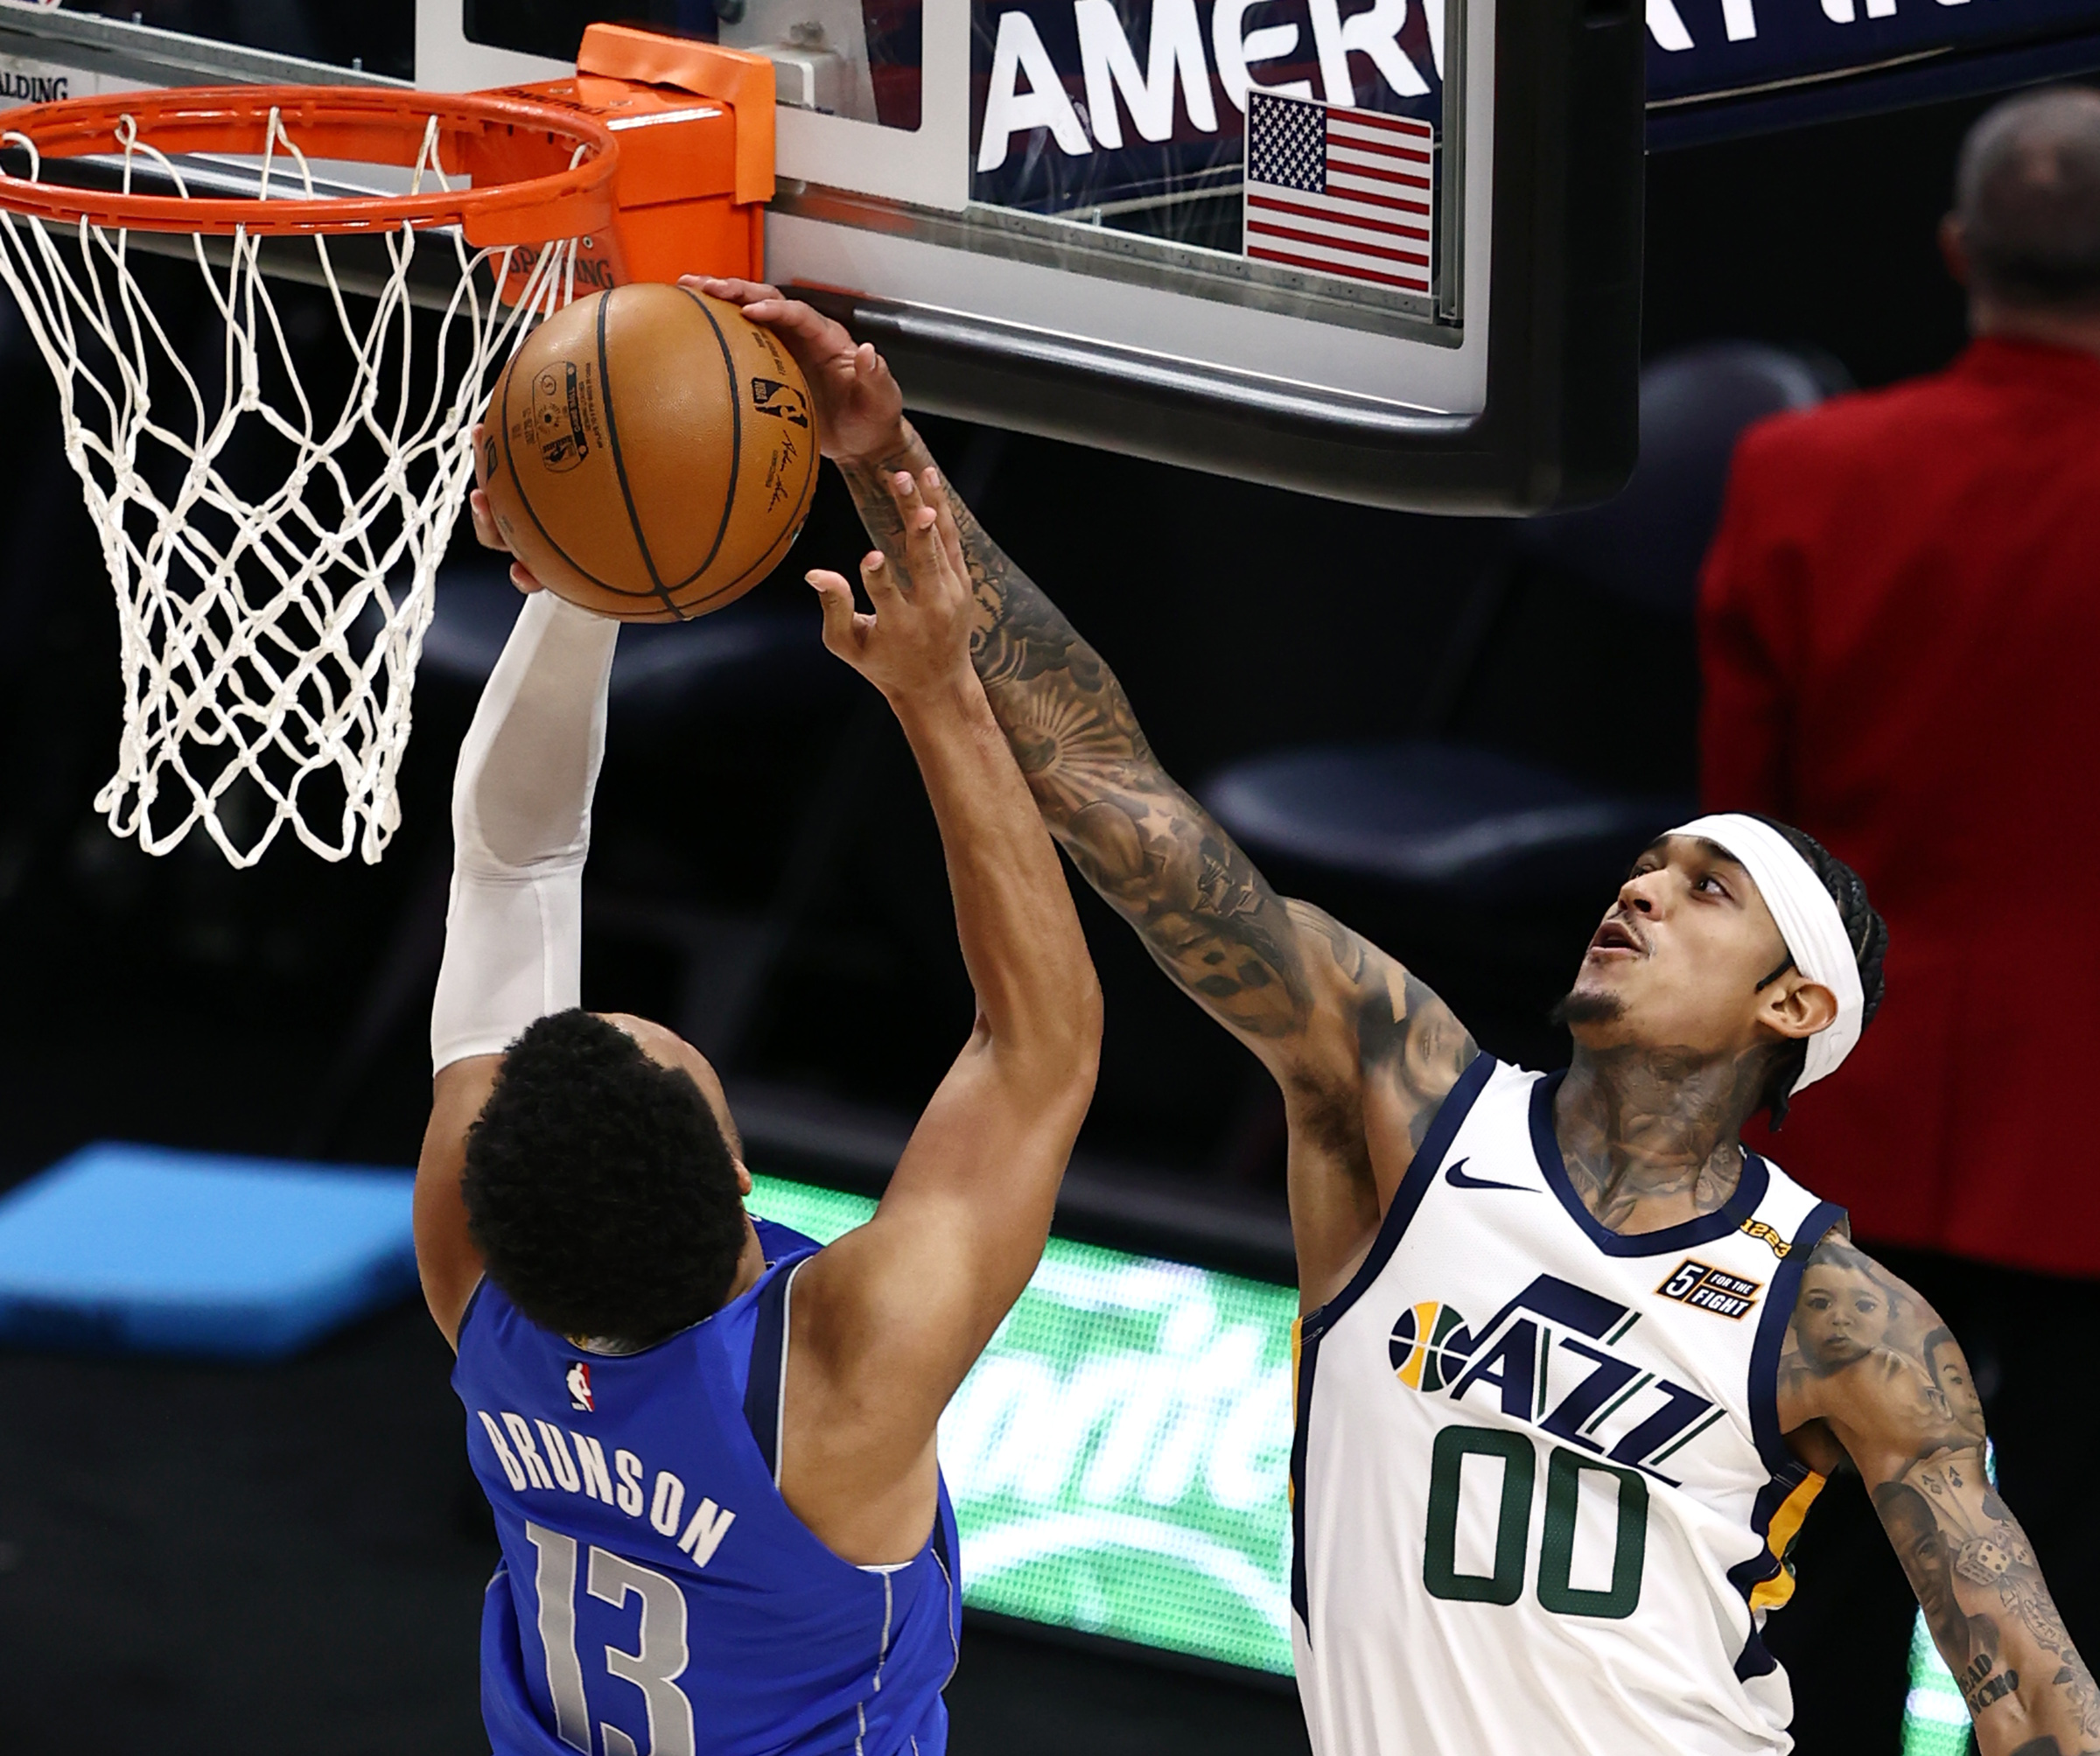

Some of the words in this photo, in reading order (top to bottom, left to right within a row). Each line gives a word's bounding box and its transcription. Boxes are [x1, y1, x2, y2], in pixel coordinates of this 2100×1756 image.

[1665, 1264, 1704, 1297] 5
[1710, 1274, 1732, 1288] FOR
[1731, 1280, 1754, 1295] THE
[1740, 1218, 1792, 1258] 1223
[1690, 1289, 1749, 1316] FIGHT
[1389, 1273, 1727, 1489] JAZZ
[478, 1410, 737, 1568] BRUNSON
[1423, 1424, 1649, 1620] 00
[526, 1520, 696, 1756] 13
